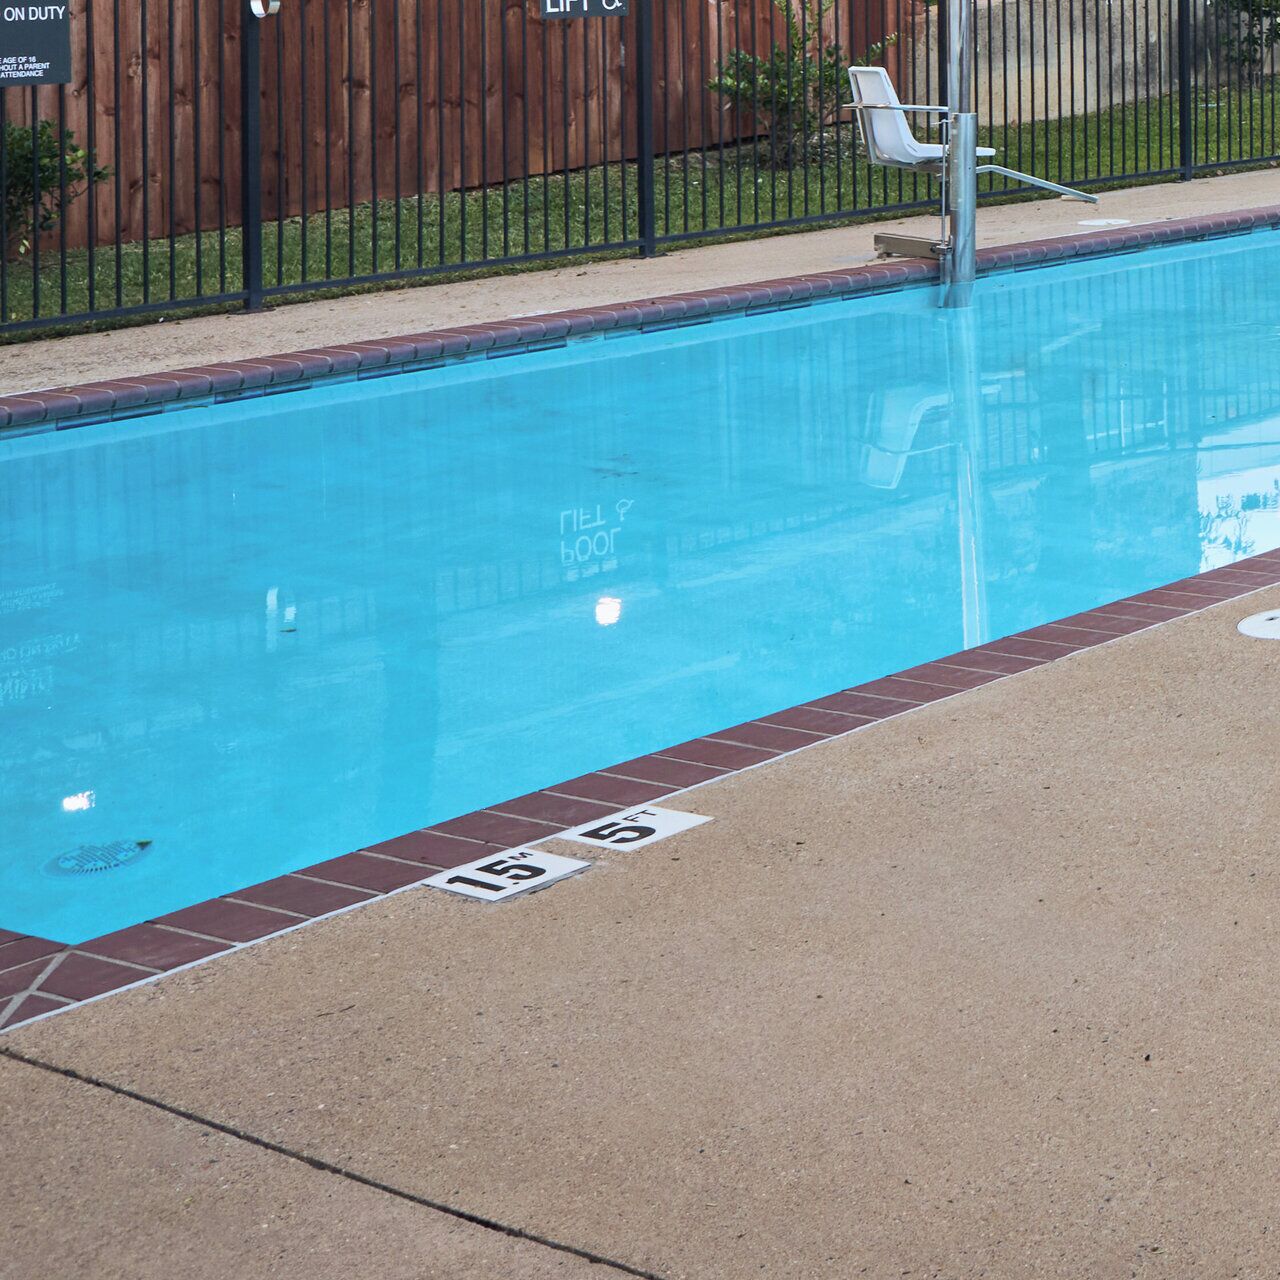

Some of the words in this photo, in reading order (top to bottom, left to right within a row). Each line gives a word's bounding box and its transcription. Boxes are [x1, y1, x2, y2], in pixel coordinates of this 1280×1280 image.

[4, 6, 25, 22] ON
[28, 5, 66, 21] DUTY
[24, 62, 50, 70] PARENT
[0, 70, 44, 78] ATTENDANCE
[507, 851, 534, 861] M
